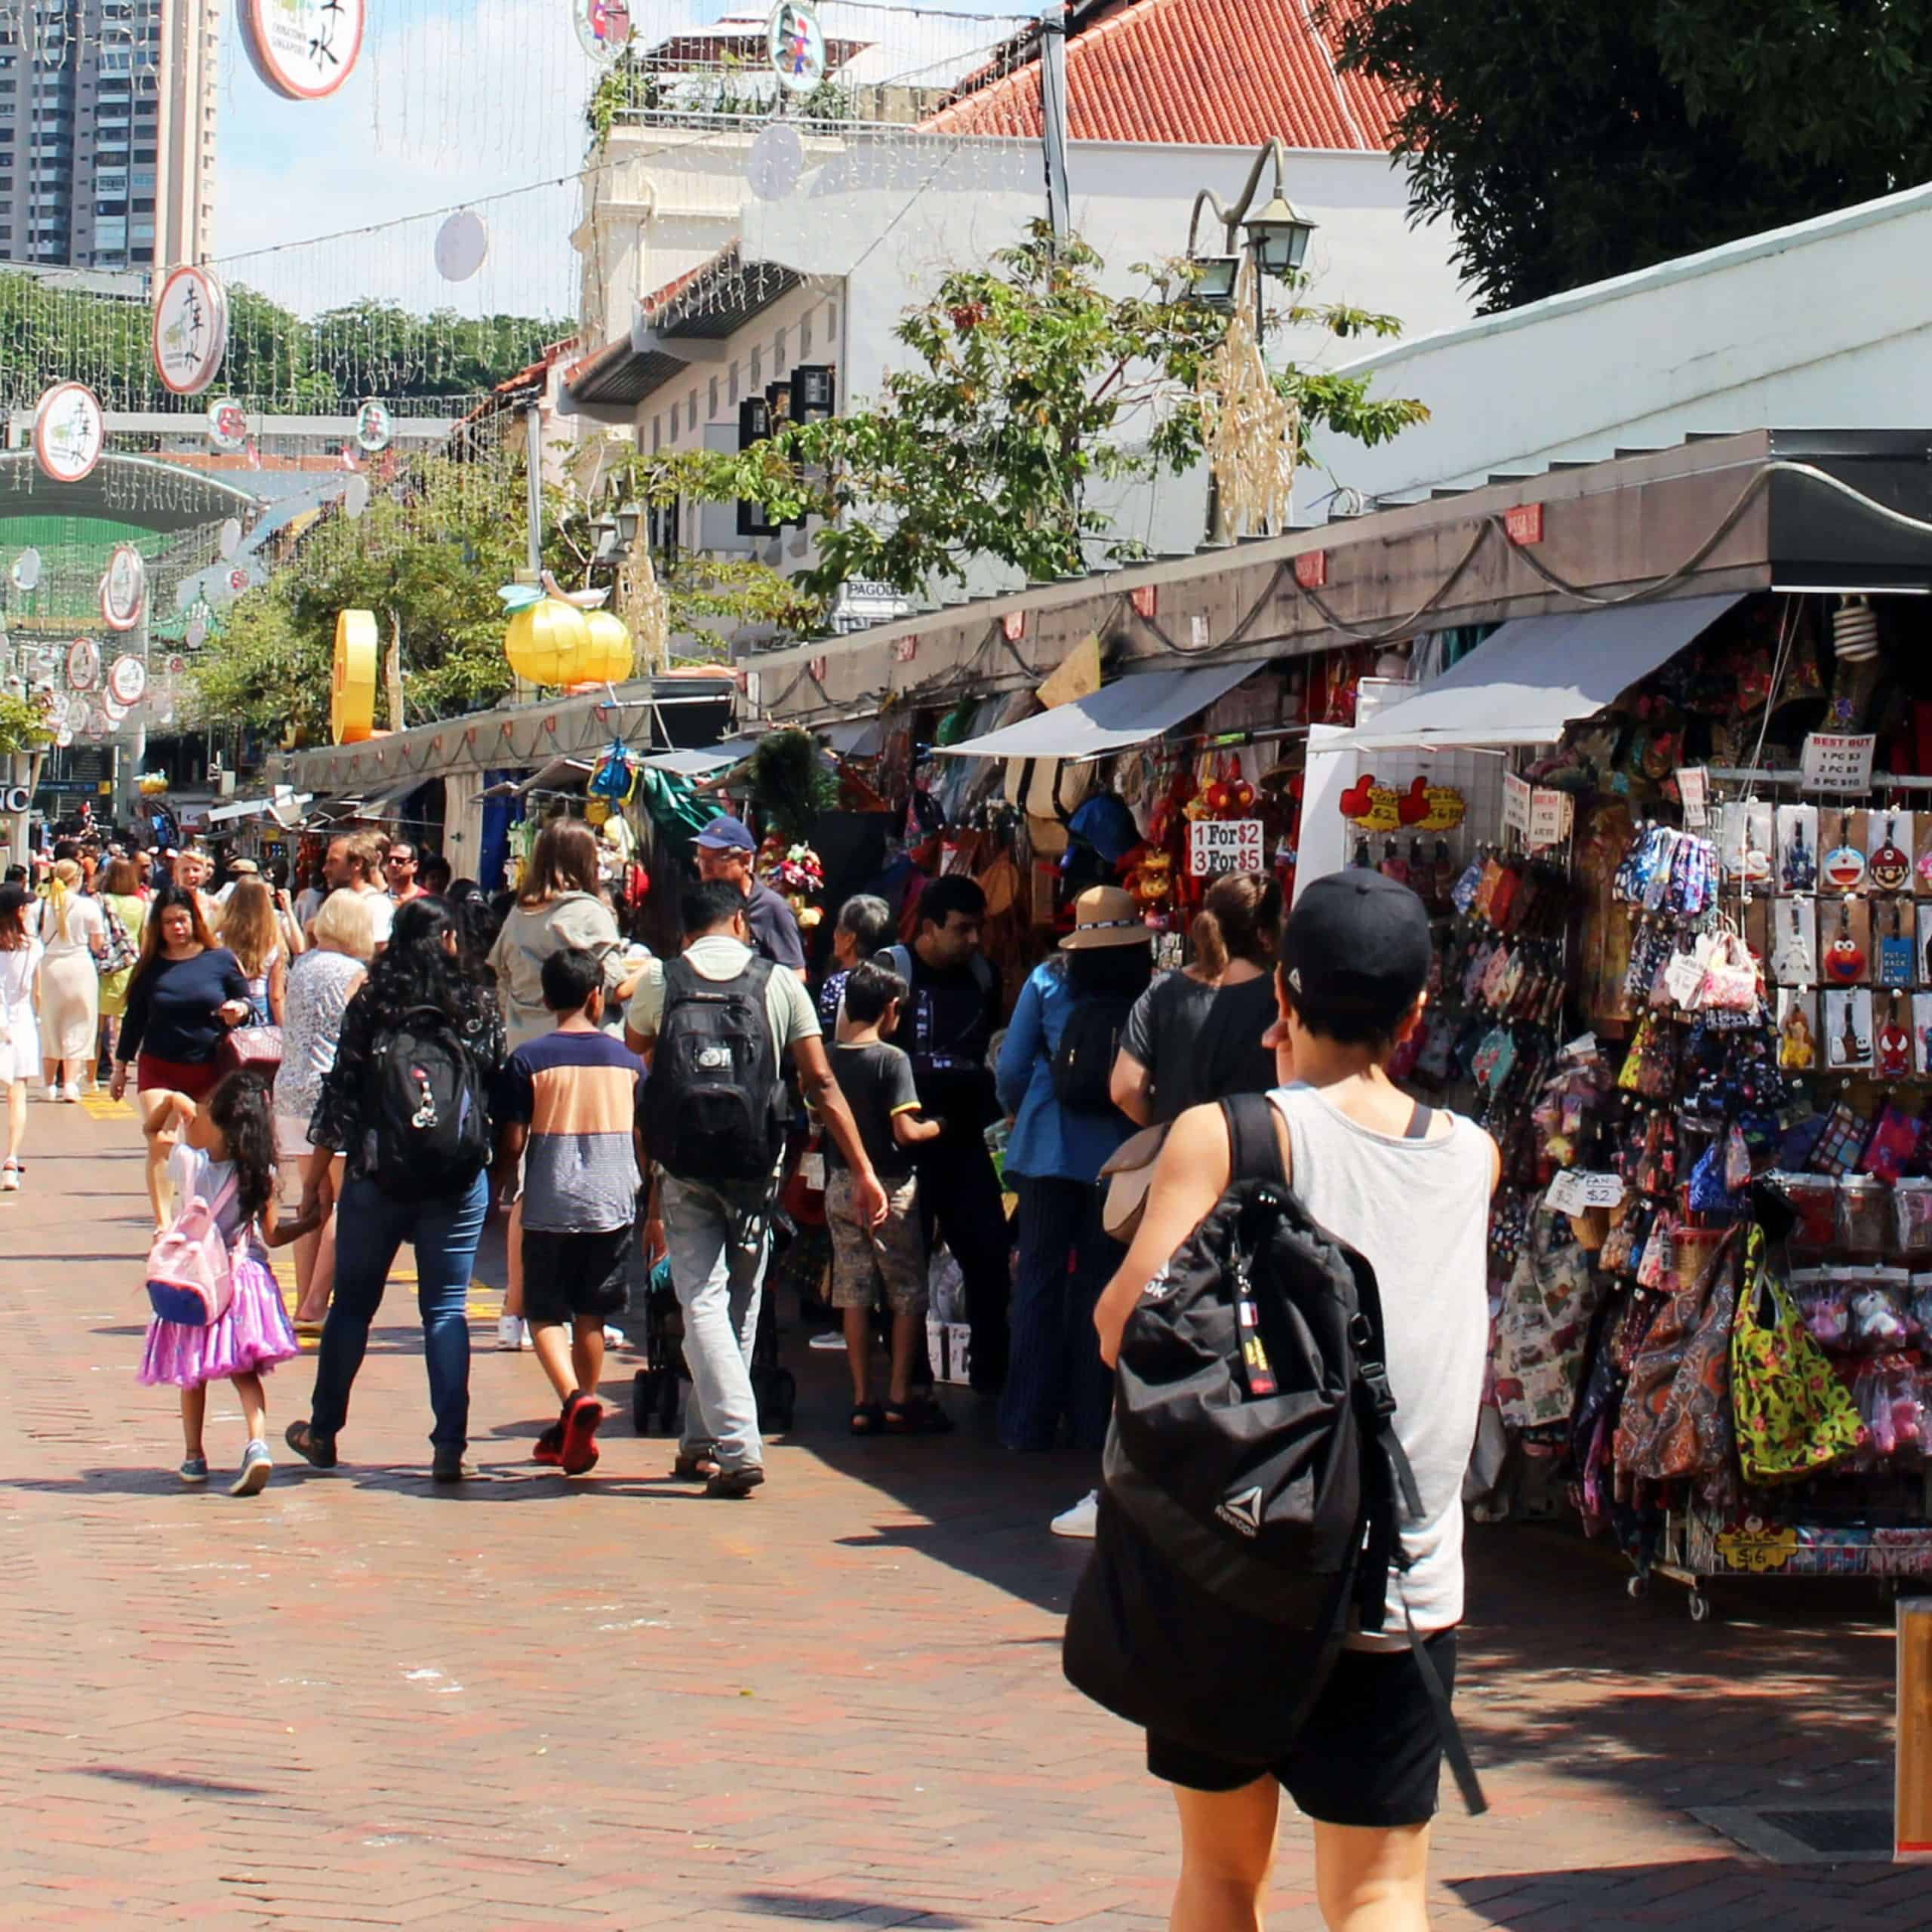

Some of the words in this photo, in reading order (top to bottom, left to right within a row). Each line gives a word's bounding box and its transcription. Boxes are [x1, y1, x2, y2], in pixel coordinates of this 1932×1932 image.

[1813, 737, 1843, 747] BEST
[1829, 764, 1843, 773] PC
[1823, 777, 1837, 786] PC
[1195, 825, 1204, 845] 1
[1195, 851, 1207, 872] 3
[1586, 1177, 1610, 1187] FAN
[1586, 1189, 1611, 1202] $2
